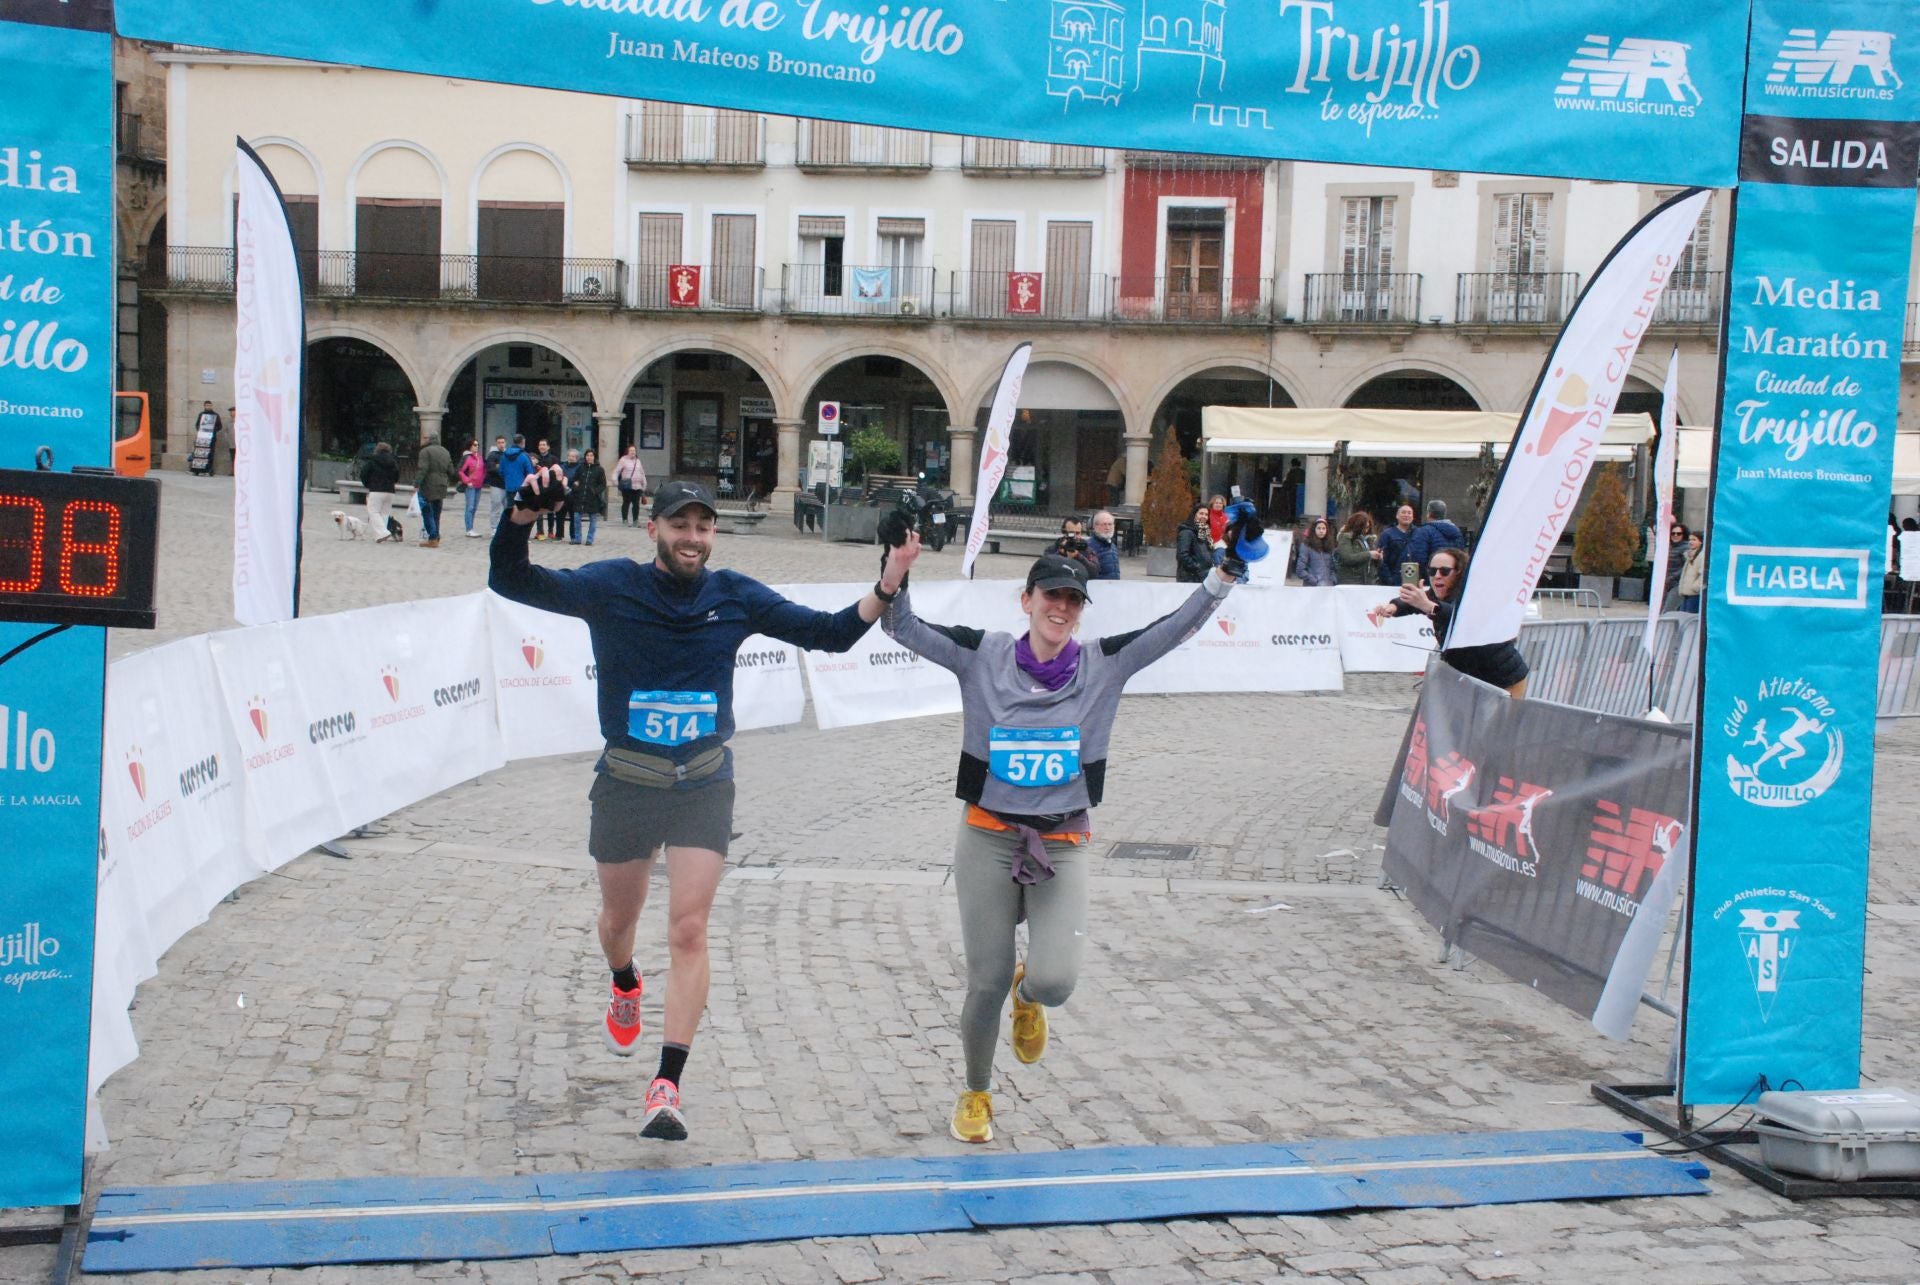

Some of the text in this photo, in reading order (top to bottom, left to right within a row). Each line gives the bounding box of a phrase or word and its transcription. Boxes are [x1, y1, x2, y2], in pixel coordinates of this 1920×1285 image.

[606, 32, 876, 84] Juan Mateos Broncano
[1280, 0, 1481, 109] Trujillo
[1554, 96, 1695, 118] www.musicrun.es
[1764, 84, 1895, 100] www.musicrun.es
[1769, 137, 1888, 169] SALIDA
[20, 277, 64, 305] de
[1752, 276, 1881, 311] Media
[1741, 325, 1889, 360] Maratón
[1755, 370, 1861, 397] Ciudad de
[1735, 399, 1878, 462] Trujillo
[1736, 466, 1873, 483] Juan Mateos Broncano
[1746, 564, 1846, 591] HABLA
[1758, 677, 1837, 718] Atletismo
[645, 711, 700, 741] 514
[1724, 695, 1748, 738] Club
[1007, 753, 1064, 781] 576
[11, 795, 28, 806] LA
[32, 794, 82, 806] MAGIA
[1733, 776, 1816, 801] TRUJILLO
[1713, 899, 1734, 921] Club
[1789, 889, 1810, 902] San
